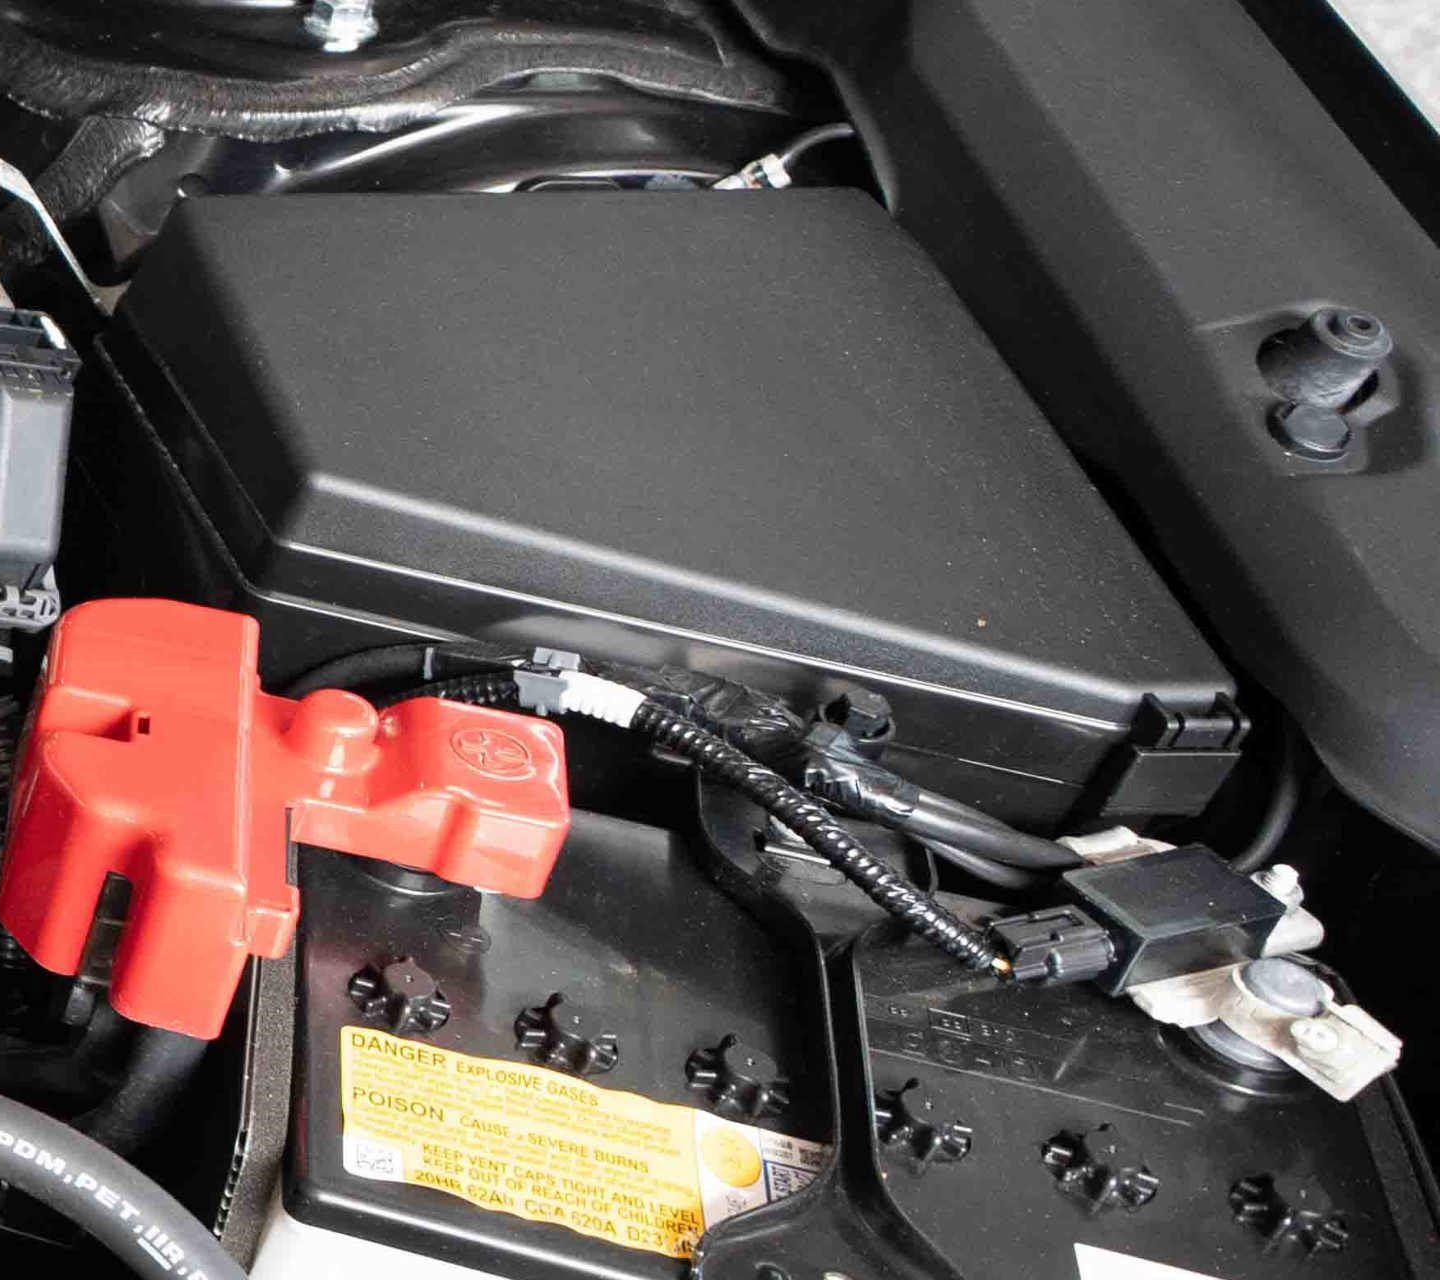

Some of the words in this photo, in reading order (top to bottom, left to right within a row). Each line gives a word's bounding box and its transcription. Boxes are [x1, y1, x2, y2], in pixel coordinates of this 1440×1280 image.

[351, 1032, 447, 1067] DANGER
[455, 1060, 542, 1091] EXPLOSIVE
[547, 1082, 599, 1108] GASES
[352, 1086, 445, 1122] POISON
[459, 1114, 509, 1139] CAUSE
[527, 1132, 589, 1158] SEVERE
[594, 1148, 650, 1173] BURNS
[422, 1143, 463, 1163] KEEP
[469, 1152, 508, 1172] VENT
[513, 1164, 556, 1187] CAPS
[562, 1177, 606, 1199] TIGHT
[611, 1190, 647, 1210] AND
[650, 1200, 700, 1226] LEVEL
[422, 1156, 465, 1175] KEEP
[469, 1167, 502, 1186] OUT
[506, 1176, 527, 1194] OF
[531, 1184, 586, 1210] REACH
[591, 1197, 613, 1215] OF
[617, 1205, 699, 1234] CHILDREN
[524, 1198, 565, 1221] CCA
[571, 1211, 618, 1236] 620A
